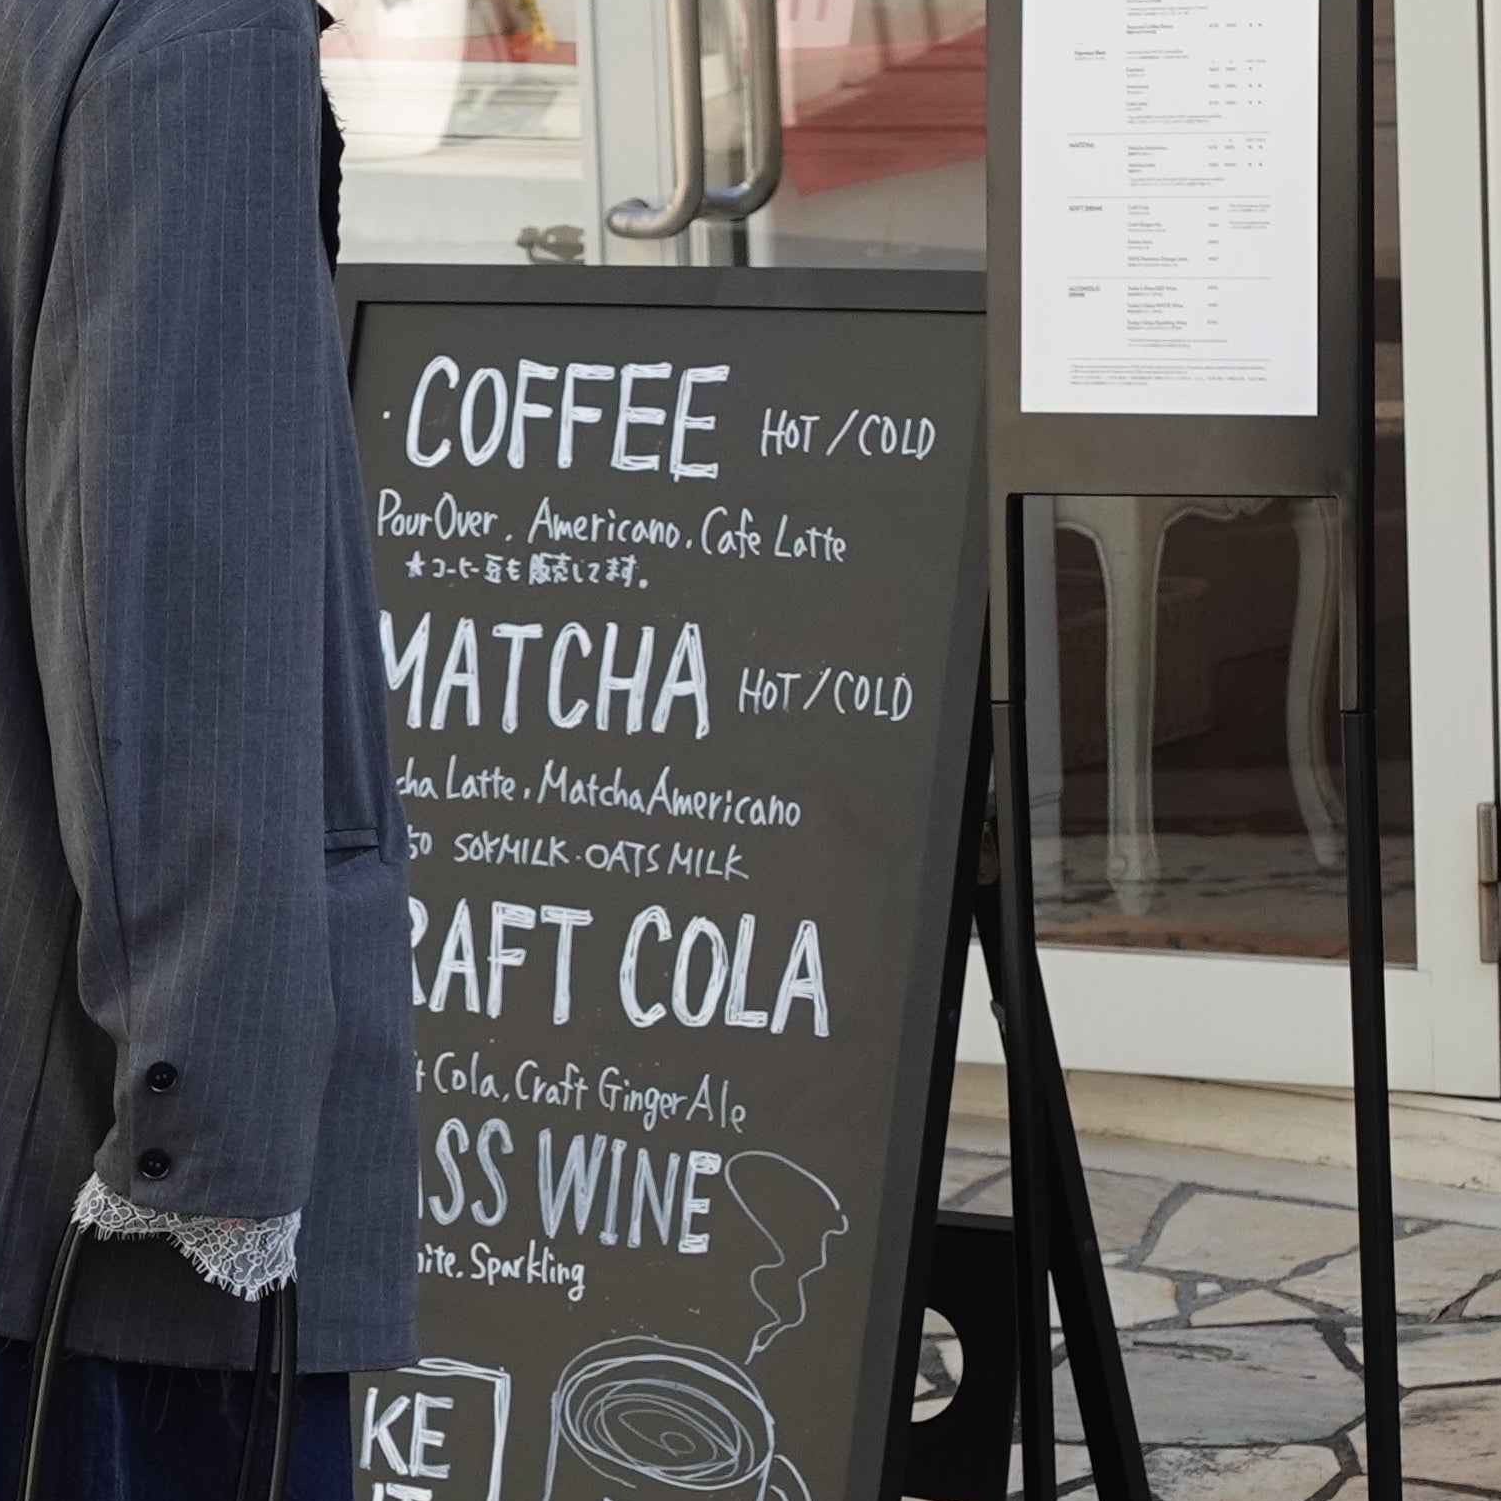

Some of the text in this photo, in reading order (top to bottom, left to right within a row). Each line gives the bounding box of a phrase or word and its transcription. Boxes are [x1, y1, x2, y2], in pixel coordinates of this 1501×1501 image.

[405, 355, 731, 483] COFFEE
[701, 505, 762, 559] Cafe
[774, 514, 847, 563] Latte
[378, 609, 711, 740] MATCHA
[667, 842, 750, 881] MILK
[619, 904, 830, 1038] COLA
[515, 1059, 589, 1110] Craft
[598, 1066, 688, 1132] Ginger
[685, 1073, 747, 1134] Ale
[417, 1117, 724, 1254] SS WINE
[470, 1239, 586, 1302] Sparkling
